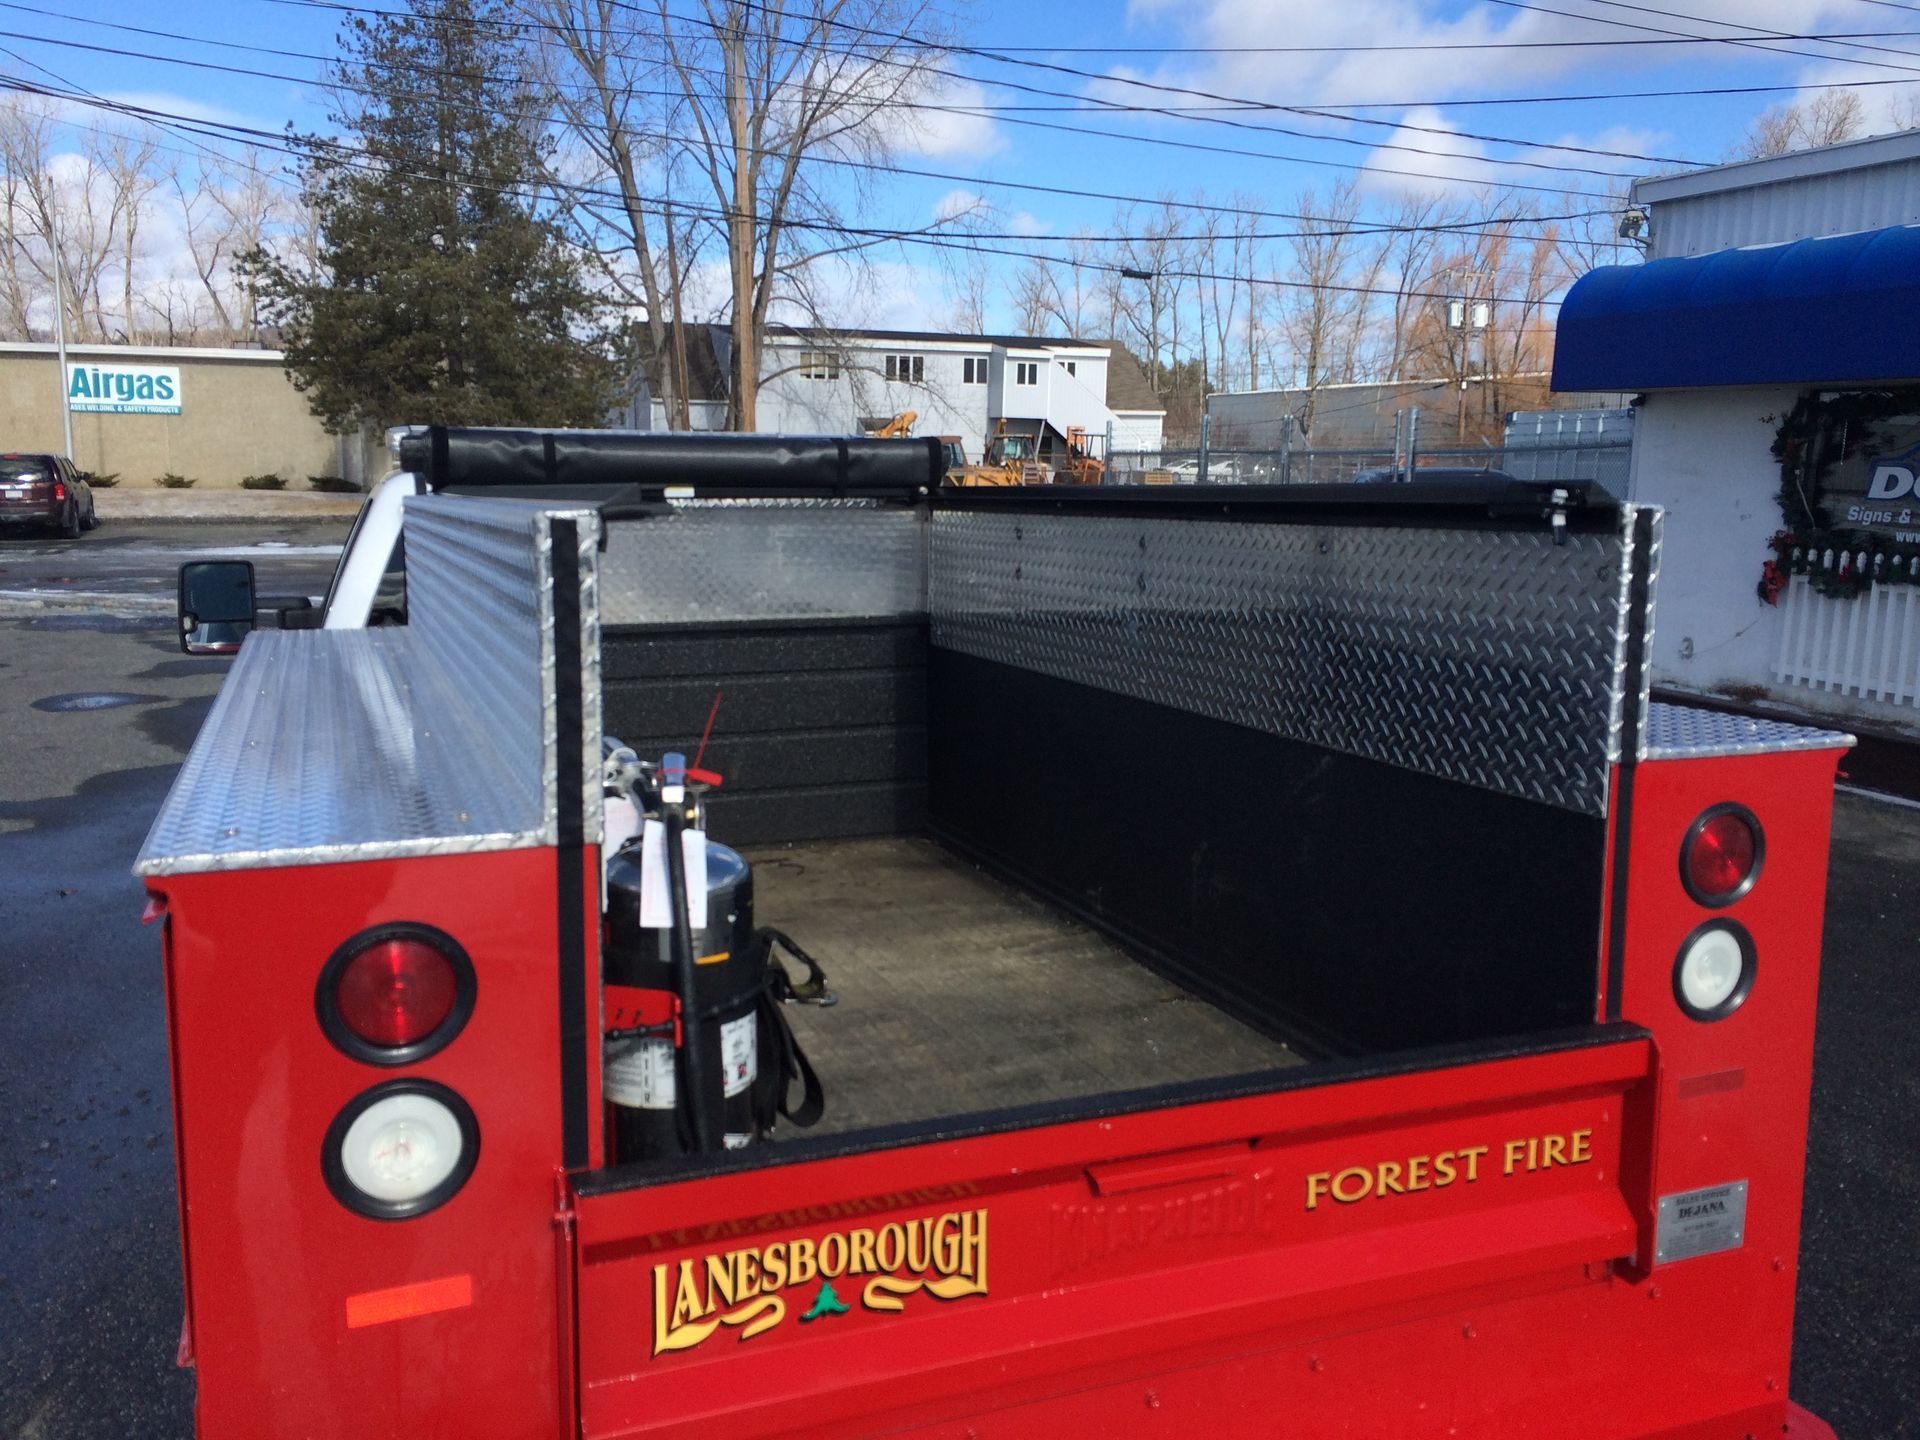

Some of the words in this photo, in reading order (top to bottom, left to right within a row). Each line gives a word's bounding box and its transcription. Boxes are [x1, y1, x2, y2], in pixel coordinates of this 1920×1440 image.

[69, 367, 174, 402] Airgas
[1847, 505, 1893, 526] Signs
[1898, 508, 1912, 524] &
[1305, 1145, 1489, 1210] FOREST
[1503, 1127, 1592, 1176] FIRE
[1679, 1201, 1725, 1218] DEJANA
[653, 1207, 989, 1356] LANESBOROUGH
